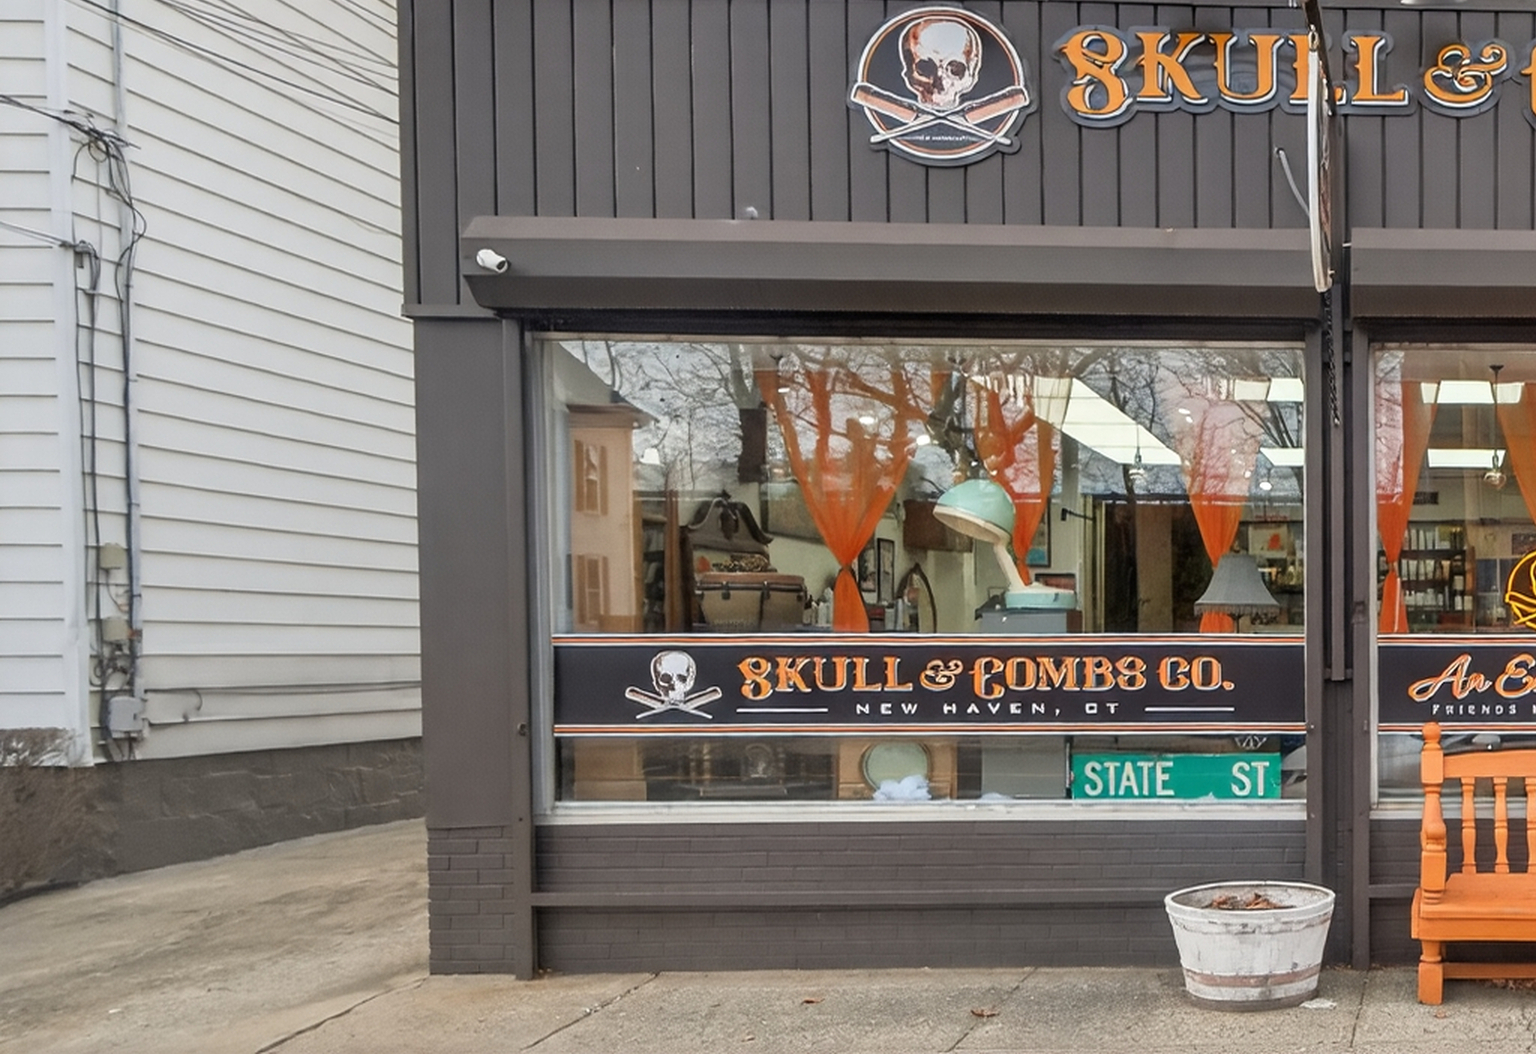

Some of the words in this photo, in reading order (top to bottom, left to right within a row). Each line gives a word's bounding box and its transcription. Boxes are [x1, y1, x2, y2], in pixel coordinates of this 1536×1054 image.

[1059, 29, 1409, 117] SKULL
[1424, 43, 1508, 109] &
[737, 655, 913, 700] SKULL
[920, 659, 964, 691] &
[969, 655, 1147, 699] COMBS
[1157, 657, 1235, 692] CO.
[1408, 653, 1492, 703] An
[855, 703, 919, 715] NEW
[943, 703, 1061, 718] HAVEN,
[1431, 703, 1518, 716] FRIENDS
[1083, 760, 1175, 797] STATE
[1230, 759, 1270, 796] ST
